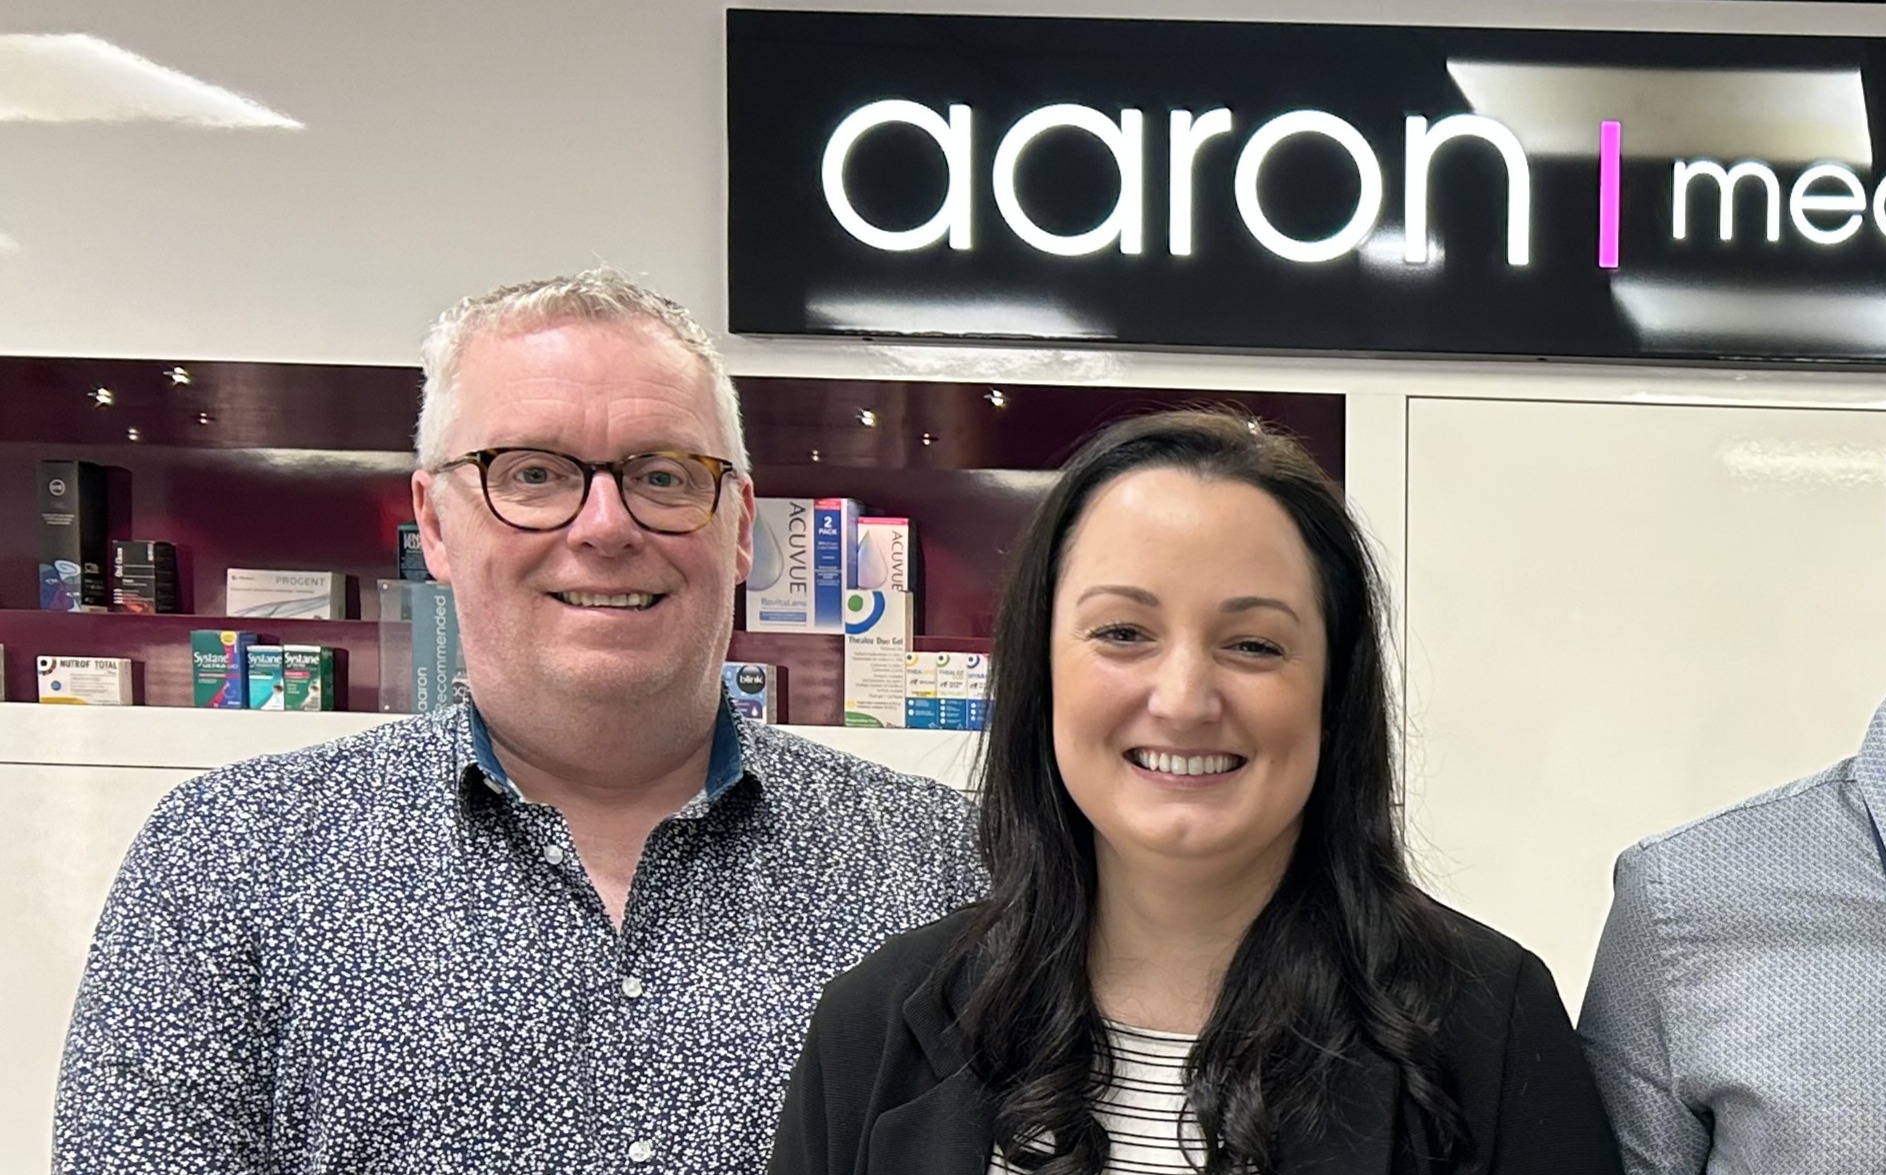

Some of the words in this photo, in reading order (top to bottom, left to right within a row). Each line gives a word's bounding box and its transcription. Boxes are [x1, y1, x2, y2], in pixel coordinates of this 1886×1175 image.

[821, 98, 1531, 267] aaron
[823, 516, 833, 529] 2
[818, 528, 838, 536] PACK
[788, 501, 807, 596] ACUVUE
[891, 530, 904, 592] ACUVUE
[275, 576, 326, 587] PROGENT
[60, 659, 90, 668] NUTROF
[95, 661, 117, 670] TOTAL
[193, 651, 230, 666] Systane
[247, 653, 282, 668] Systane
[284, 652, 320, 668] Systane
[740, 674, 763, 684] blink
[416, 666, 428, 712] aaron
